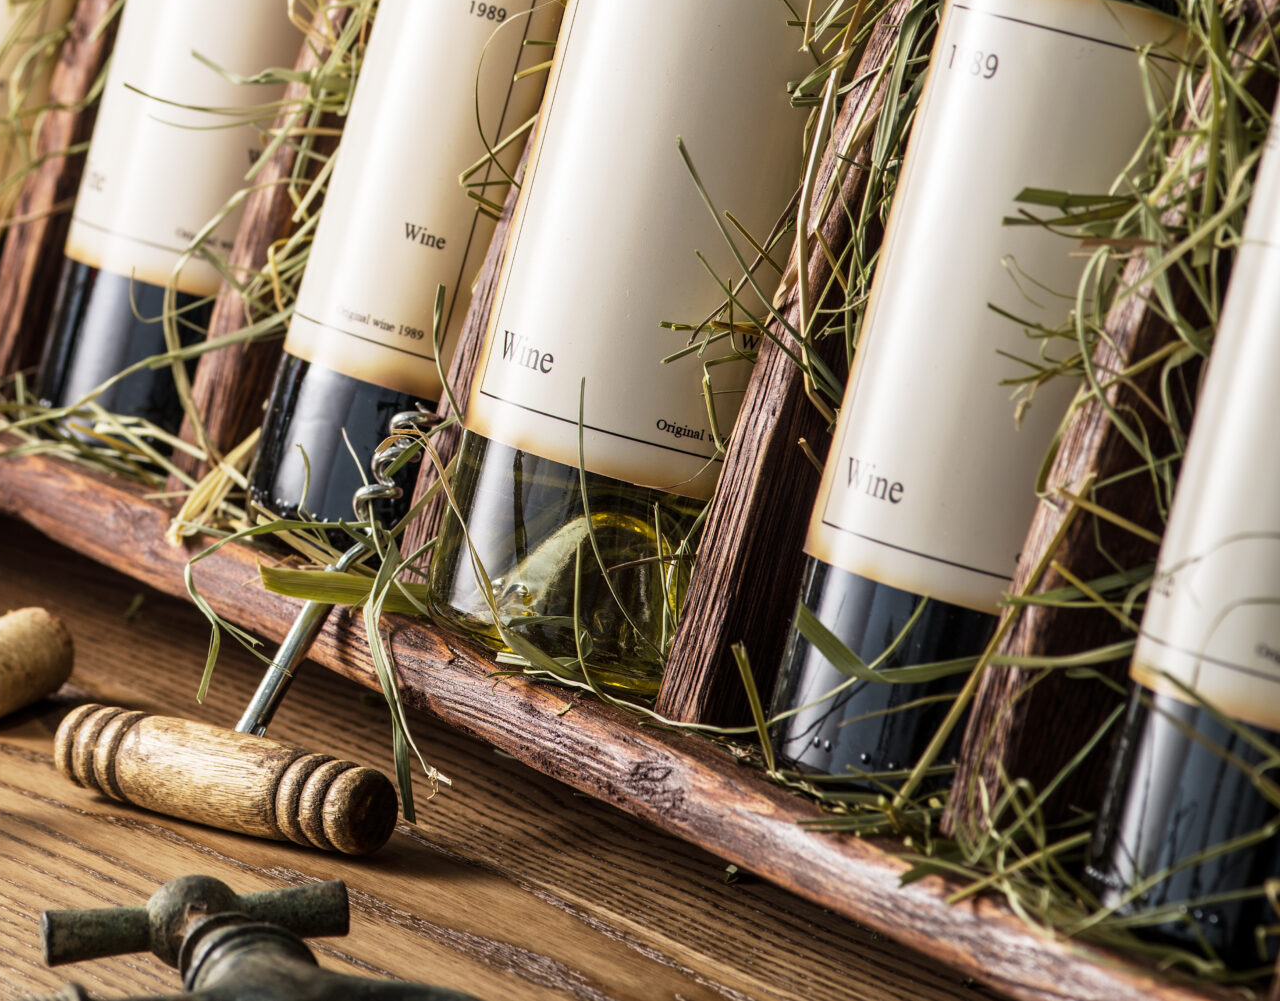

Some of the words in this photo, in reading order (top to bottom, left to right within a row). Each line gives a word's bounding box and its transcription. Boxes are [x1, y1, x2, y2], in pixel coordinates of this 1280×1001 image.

[469, 0, 507, 23] 1989
[948, 43, 999, 79] 189
[404, 222, 447, 250] Wine
[398, 324, 425, 341] 1989
[502, 329, 554, 374] Wine
[656, 418, 705, 441] Original
[847, 456, 905, 505] Wine
